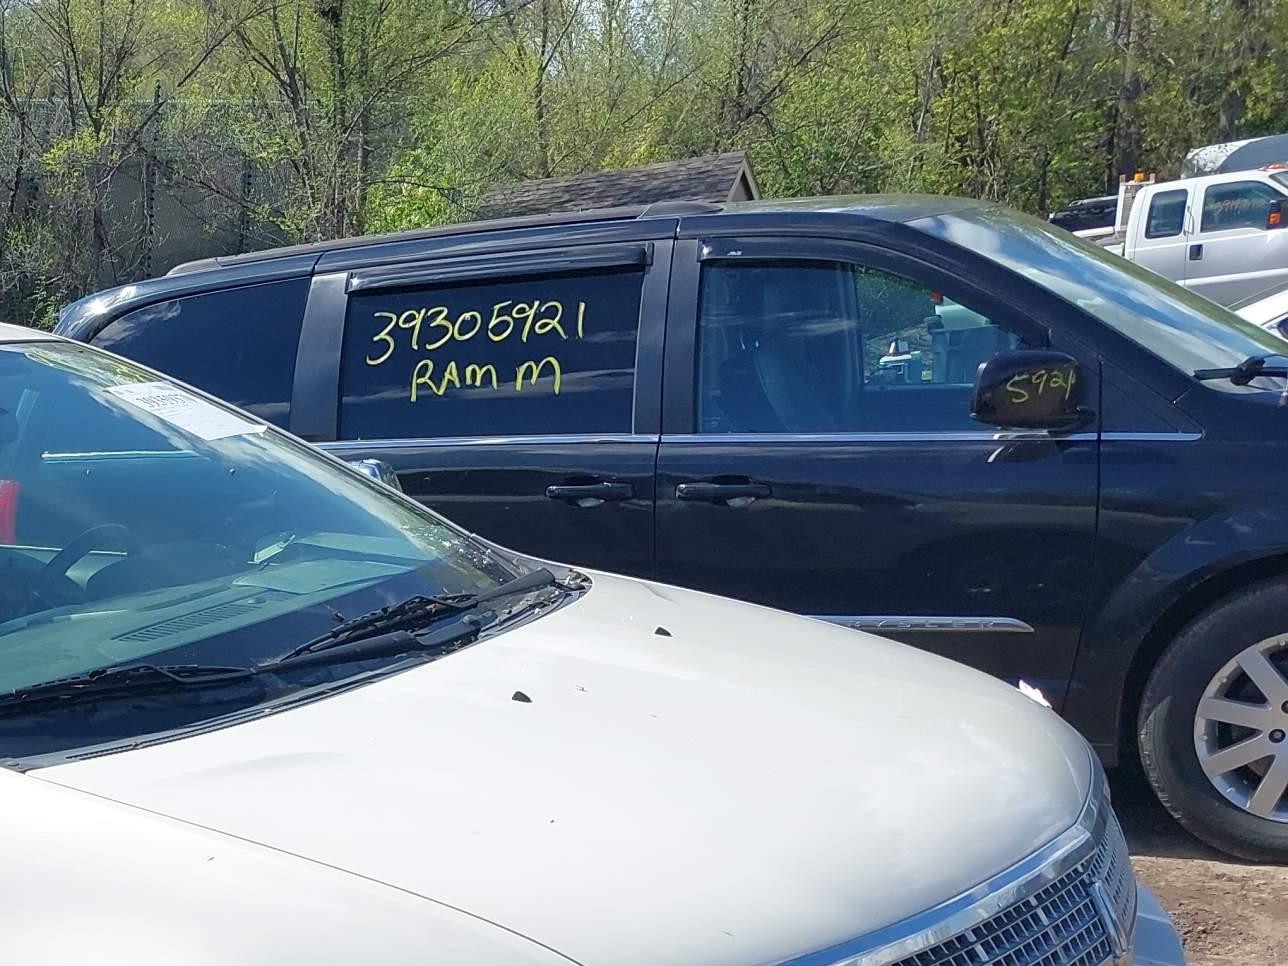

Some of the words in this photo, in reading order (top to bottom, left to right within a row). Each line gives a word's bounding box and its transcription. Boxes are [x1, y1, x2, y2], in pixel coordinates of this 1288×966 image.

[366, 300, 586, 366] 39305921
[411, 359, 498, 402] RAM
[515, 356, 561, 395] M
[1006, 369, 1076, 403] 5921
